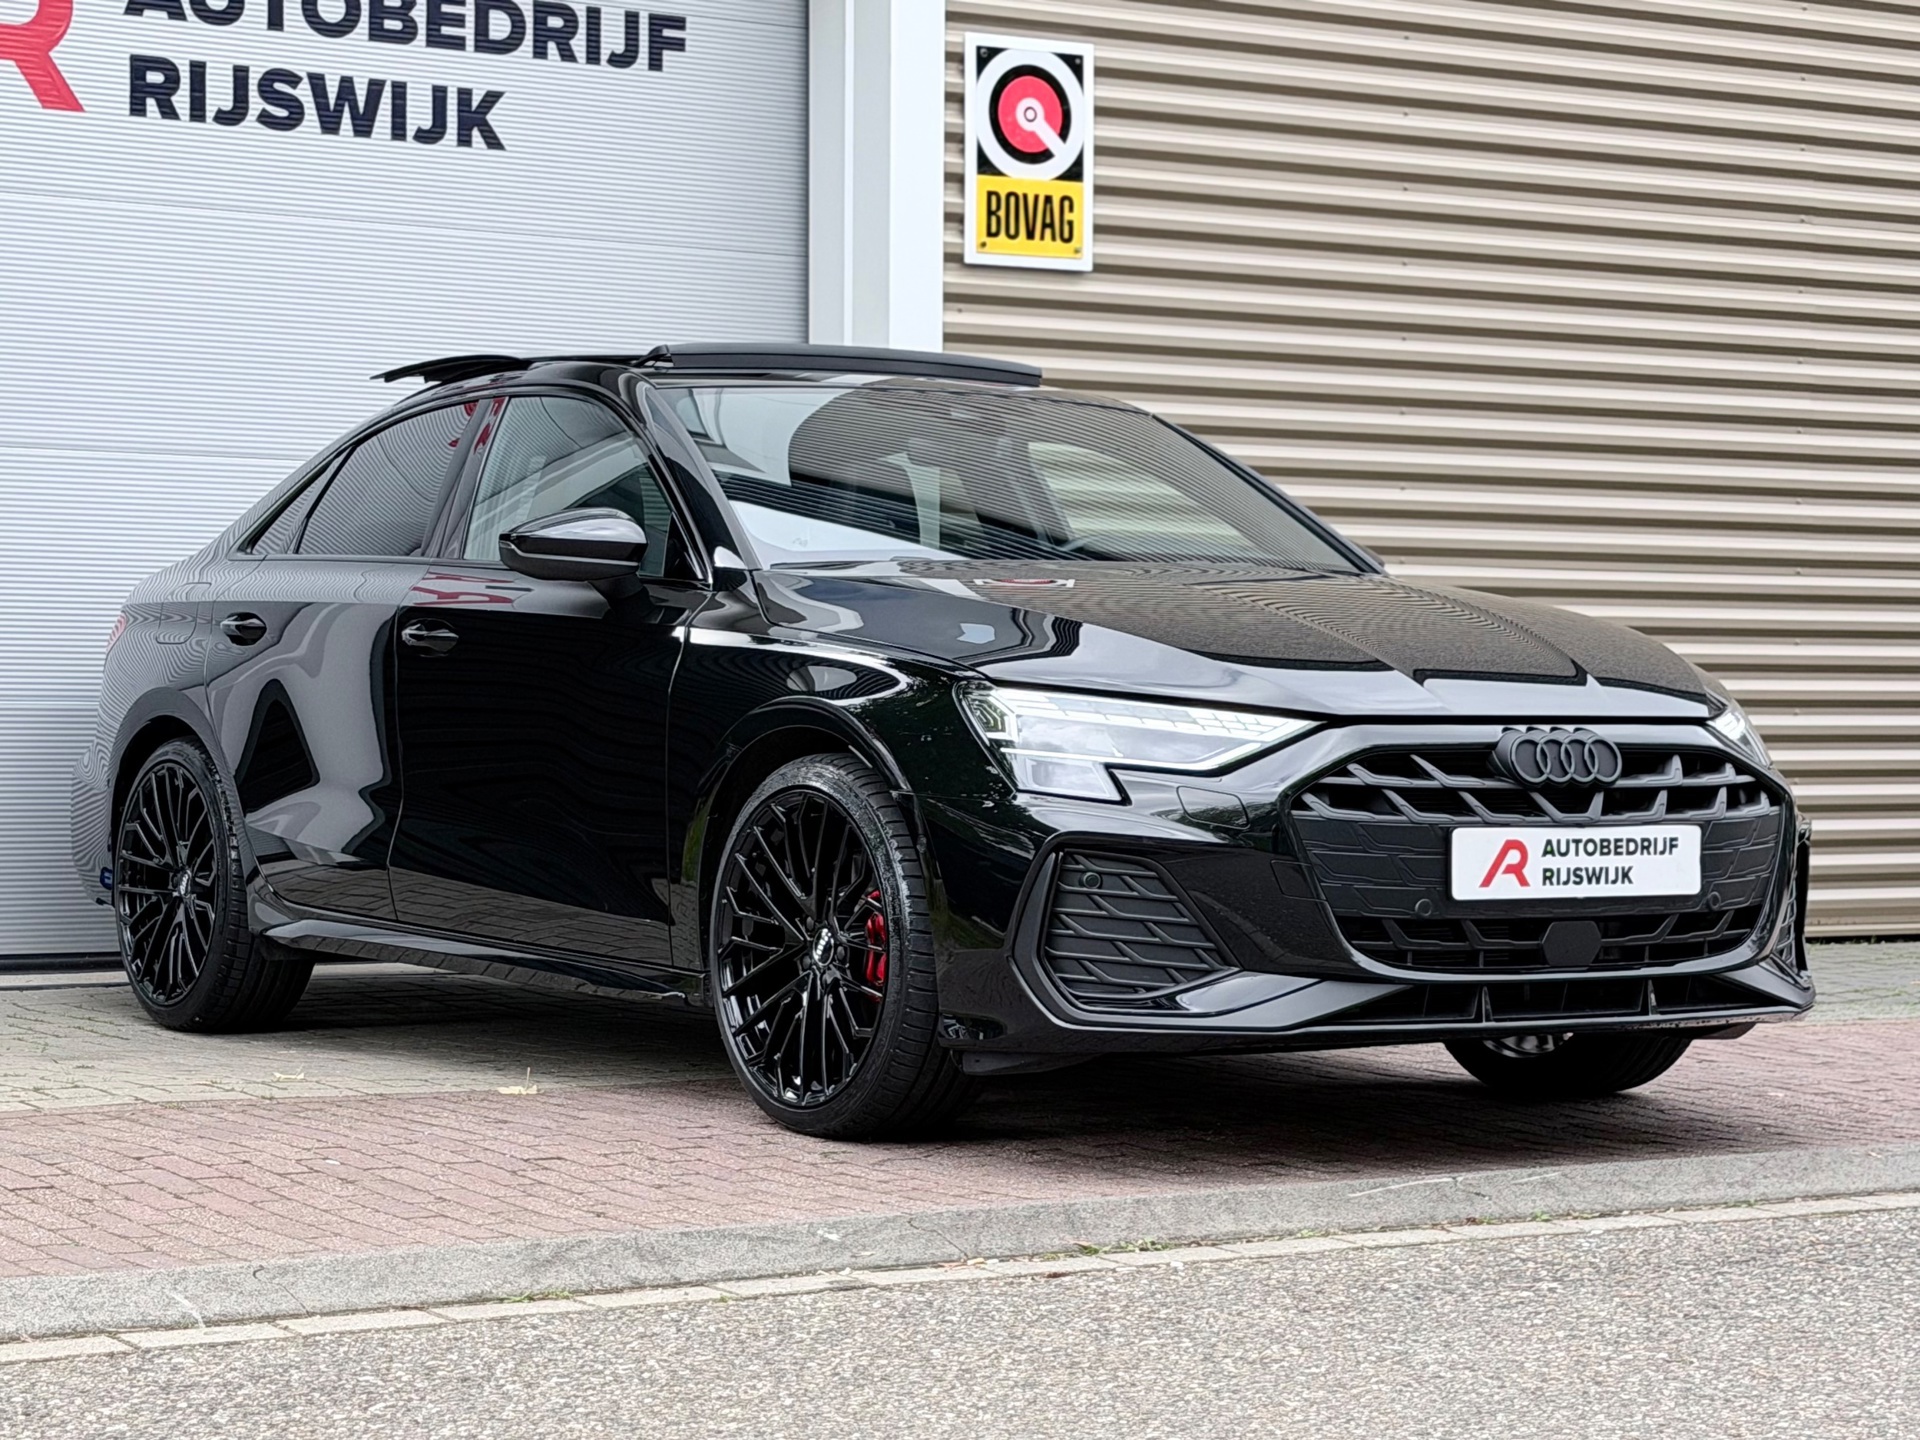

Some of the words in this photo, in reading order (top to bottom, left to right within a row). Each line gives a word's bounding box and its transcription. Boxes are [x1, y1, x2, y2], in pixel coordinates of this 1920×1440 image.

[123, 0, 687, 72] OBEDRIJF
[129, 54, 507, 151] RIJSWIJK
[985, 190, 1075, 243] BOVAG
[1541, 837, 1679, 858] AUTOBEDRIJF
[1541, 866, 1634, 886] RIJSWIJK
